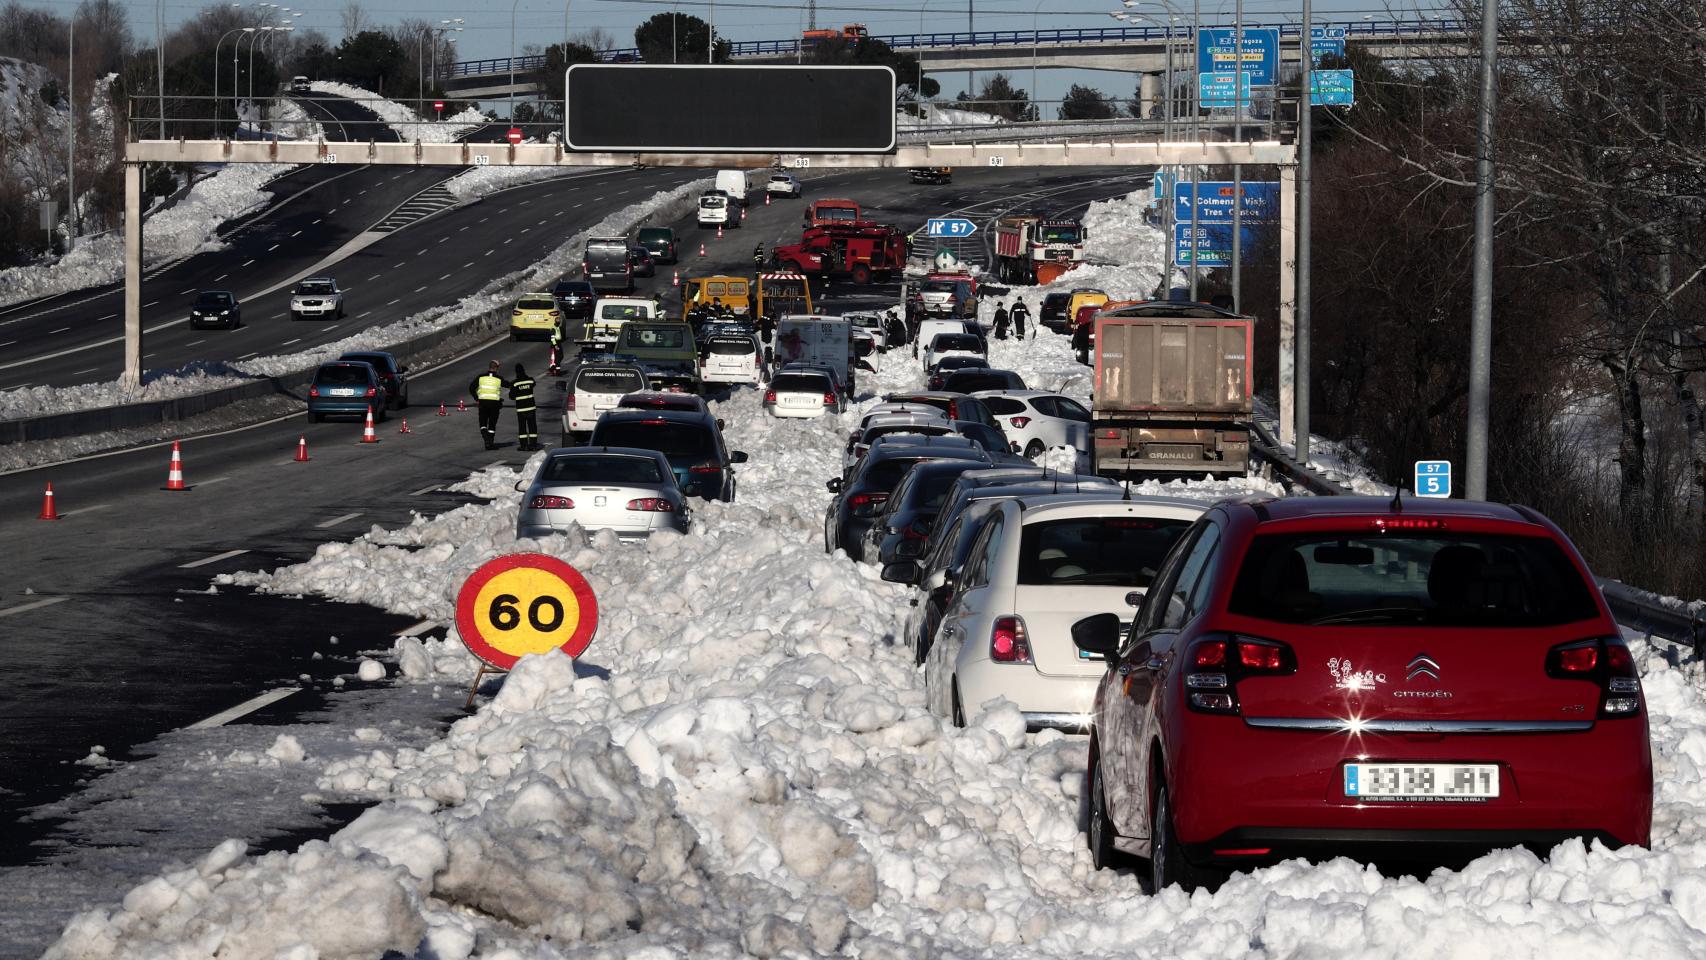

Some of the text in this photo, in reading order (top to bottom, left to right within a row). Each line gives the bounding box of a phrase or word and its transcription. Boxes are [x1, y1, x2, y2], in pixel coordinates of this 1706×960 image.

[1197, 197, 1236, 205] Colmena
[951, 222, 967, 233] 57
[1149, 452, 1194, 460] GRANALU
[1427, 464, 1440, 472] 57
[1428, 477, 1440, 492] 5
[489, 594, 564, 633] 60
